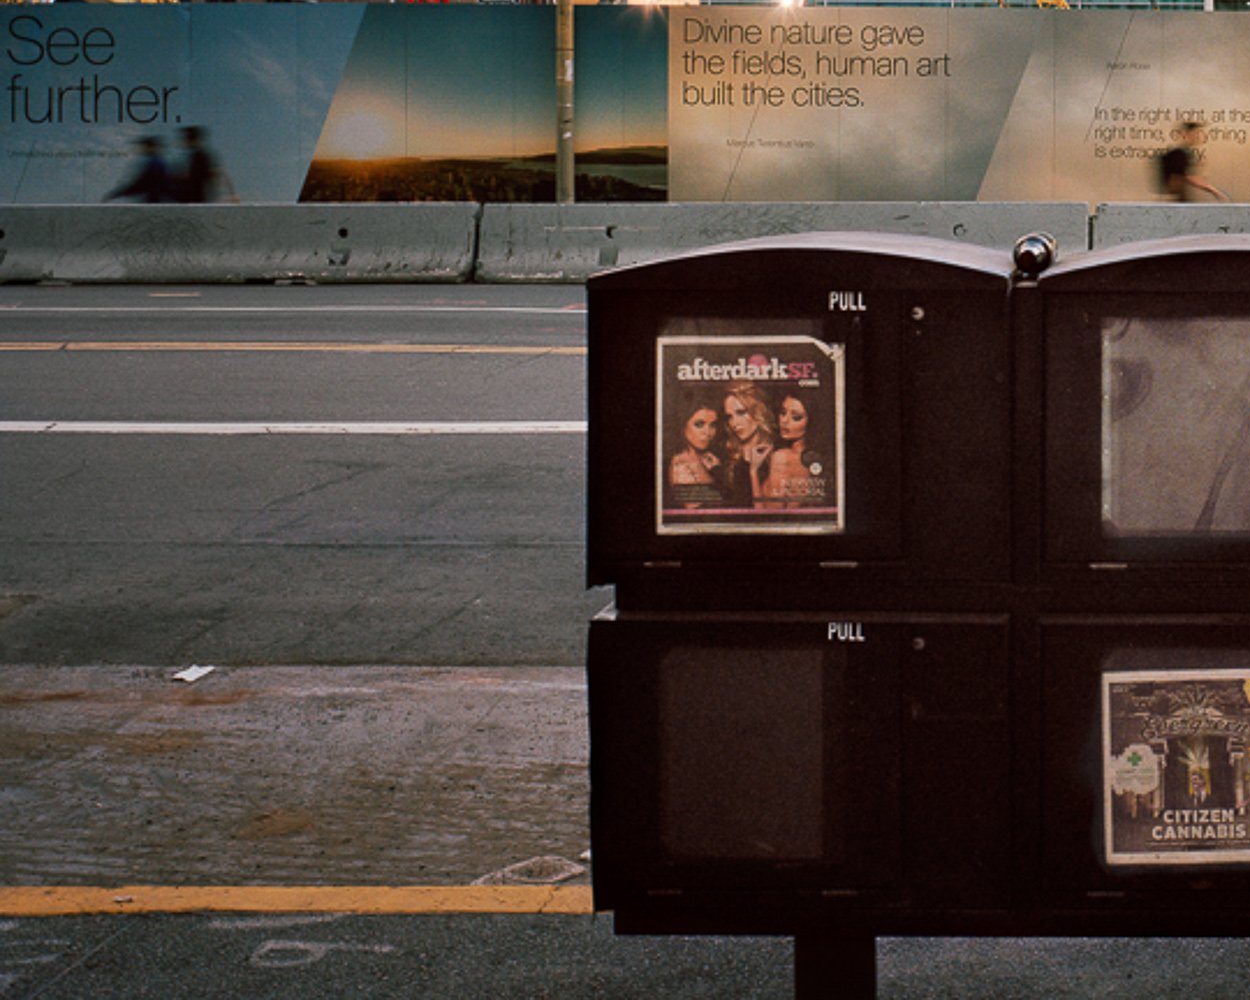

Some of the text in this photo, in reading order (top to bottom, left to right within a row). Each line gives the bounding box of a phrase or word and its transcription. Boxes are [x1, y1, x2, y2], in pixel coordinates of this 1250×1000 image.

[7, 15, 115, 65] See
[684, 18, 924, 51] Divine nature gave
[682, 51, 952, 78] the fields, human art
[6, 73, 181, 124] further.
[682, 81, 865, 107] built the cities.
[1094, 106, 1109, 121] In
[1111, 107, 1136, 122] the
[1138, 107, 1172, 125] right
[1211, 109, 1226, 123] at
[1094, 126, 1127, 143] right
[1094, 145, 1105, 159] is
[829, 291, 867, 311] PULL
[827, 622, 866, 642] PULL
[1163, 808, 1235, 824] CITIZEN
[1151, 824, 1247, 841] CANNABIS
